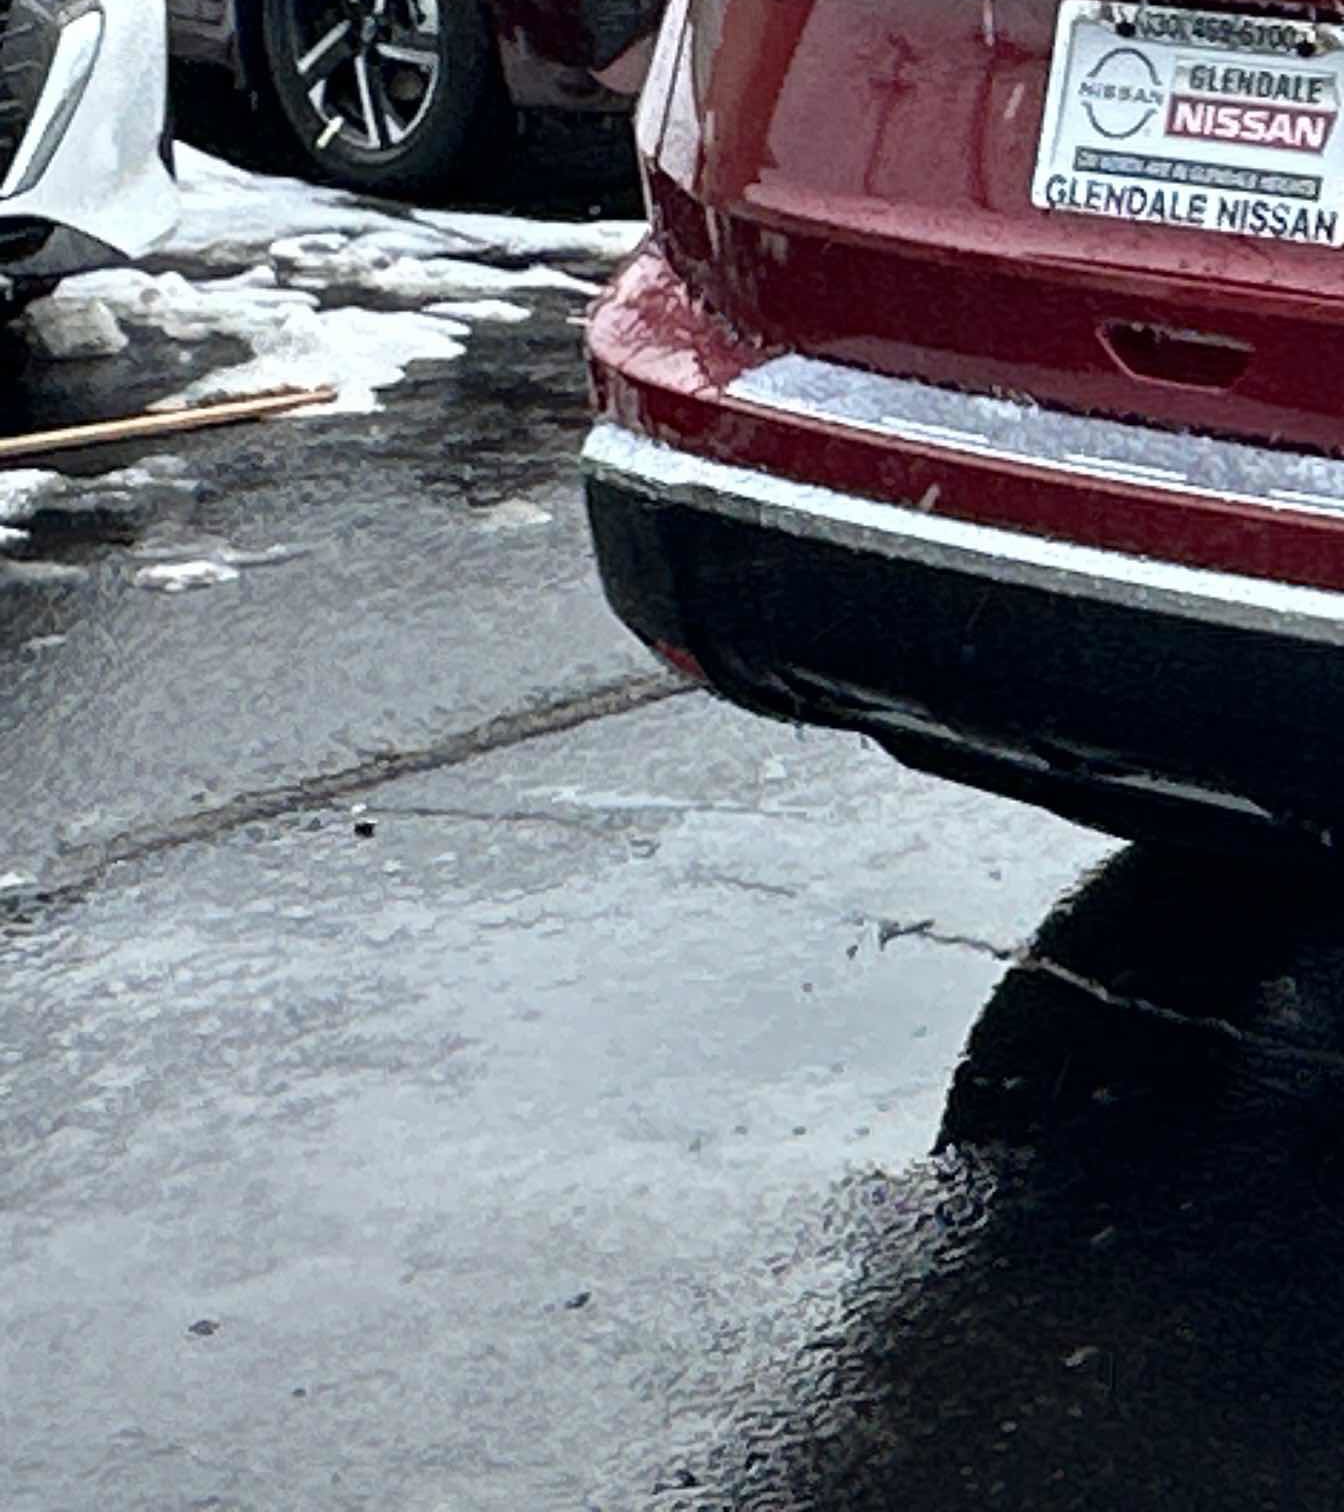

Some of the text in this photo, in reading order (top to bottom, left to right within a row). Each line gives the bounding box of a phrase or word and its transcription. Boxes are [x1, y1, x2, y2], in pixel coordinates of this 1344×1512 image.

[1078, 81, 1164, 107] NISSAN
[1188, 64, 1324, 104] GLENDALE
[1172, 100, 1326, 148] NISSAN
[1045, 173, 1339, 242] GLENDALE NISSAN
